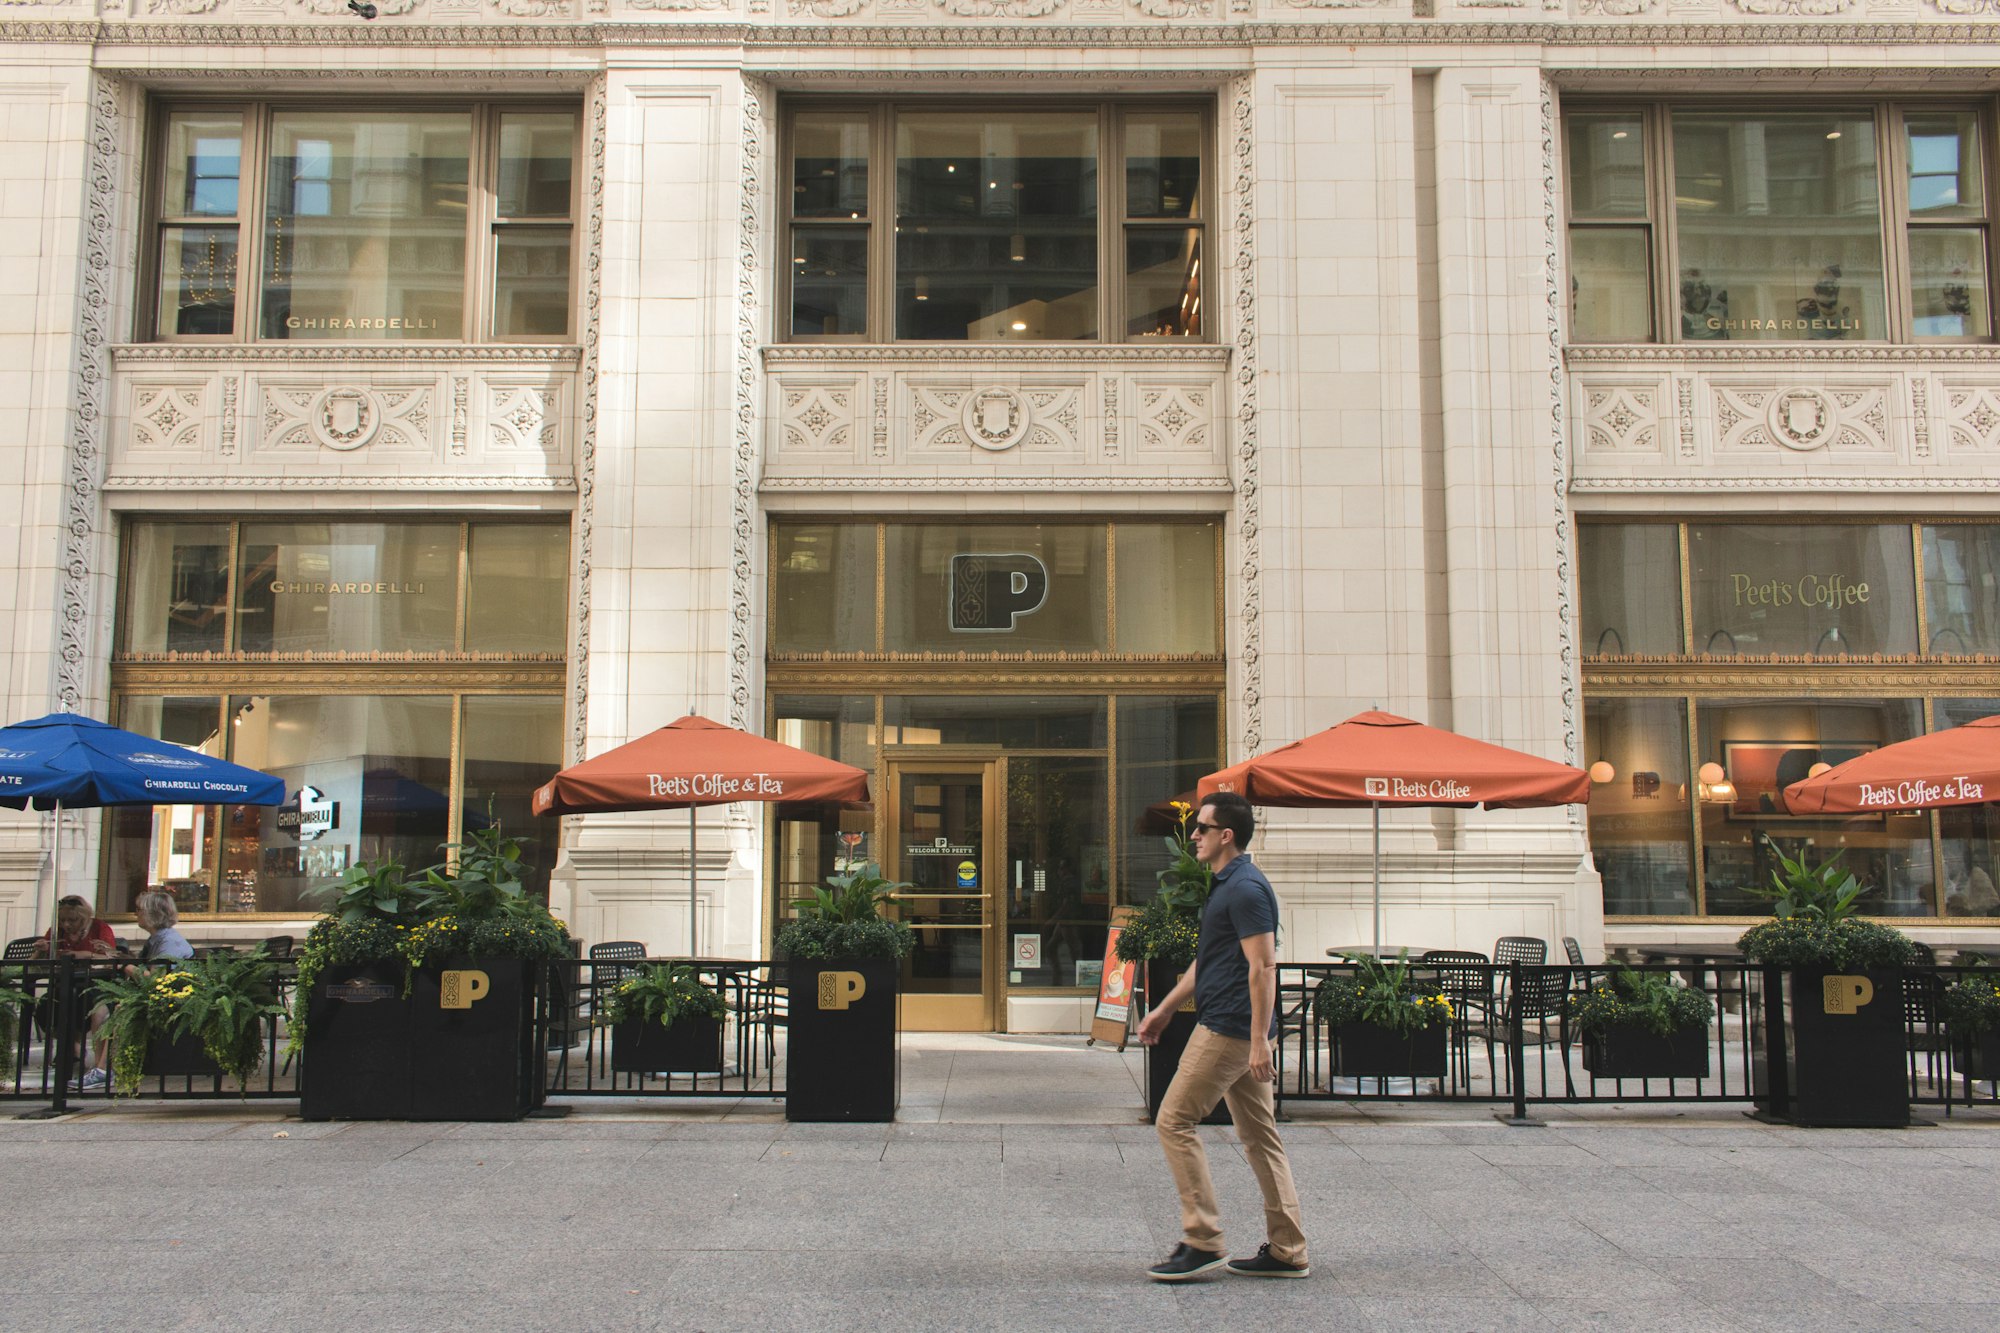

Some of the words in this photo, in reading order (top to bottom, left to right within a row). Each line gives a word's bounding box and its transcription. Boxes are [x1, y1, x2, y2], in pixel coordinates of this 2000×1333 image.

[286, 317, 437, 329] GHIRARDELLI
[1706, 317, 1860, 330] GHIRARDELLI
[269, 580, 424, 594] GHIRARDELLI
[1730, 573, 1793, 607] Peet's
[1798, 573, 1870, 610] Coffee
[145, 779, 200, 790] GHIRARDELLI
[203, 781, 248, 793] CHOCOLATE
[646, 773, 689, 796] Peet's
[692, 773, 740, 797] Coffee
[742, 778, 756, 792] &
[753, 773, 783, 795] Tea
[1392, 777, 1427, 798] Peet's
[1429, 779, 1470, 799] Coffee
[1858, 784, 1896, 806] Peet's
[1897, 780, 1941, 805] Coffee
[1943, 784, 1957, 798] &
[1953, 776, 1983, 800] Tea
[278, 809, 330, 827] GHIRARDELLI
